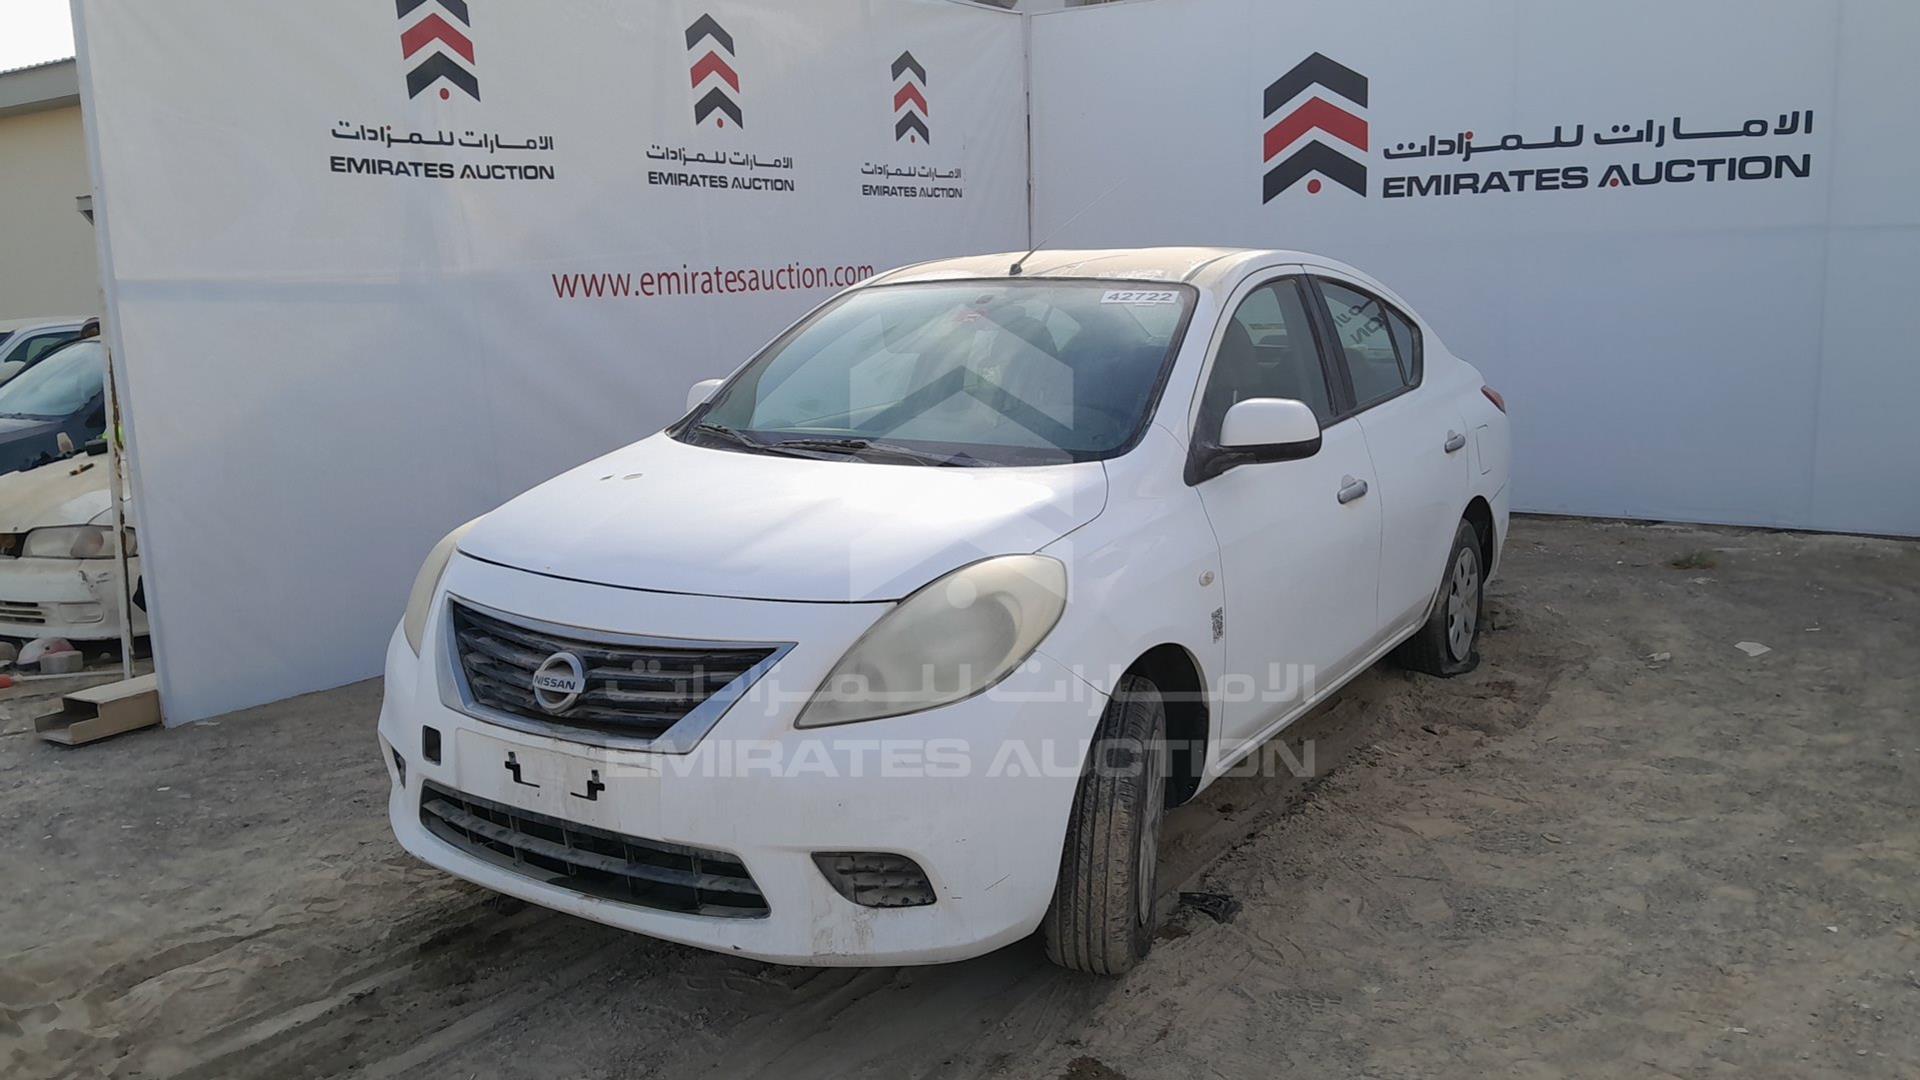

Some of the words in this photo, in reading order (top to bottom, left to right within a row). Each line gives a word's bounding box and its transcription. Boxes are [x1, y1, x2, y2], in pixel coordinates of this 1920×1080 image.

[331, 120, 454, 148] للمزادات
[1593, 110, 1814, 147] الامارات
[646, 144, 727, 166] للمزادات
[1383, 125, 1584, 162] للمزادات
[330, 156, 454, 179] EMIRATES
[459, 164, 555, 180] AUCTION
[1382, 166, 1589, 199] EMIRATES
[1597, 154, 1811, 189] AUCTION
[648, 171, 728, 188] EMIRATES
[731, 177, 795, 191] AUCTION
[862, 184, 917, 197] EMIRATES
[919, 186, 962, 198] AUCTION
[551, 262, 875, 298] www.emiratesauction.com
[1108, 292, 1173, 301] 42722
[534, 675, 576, 690] NISSAN
